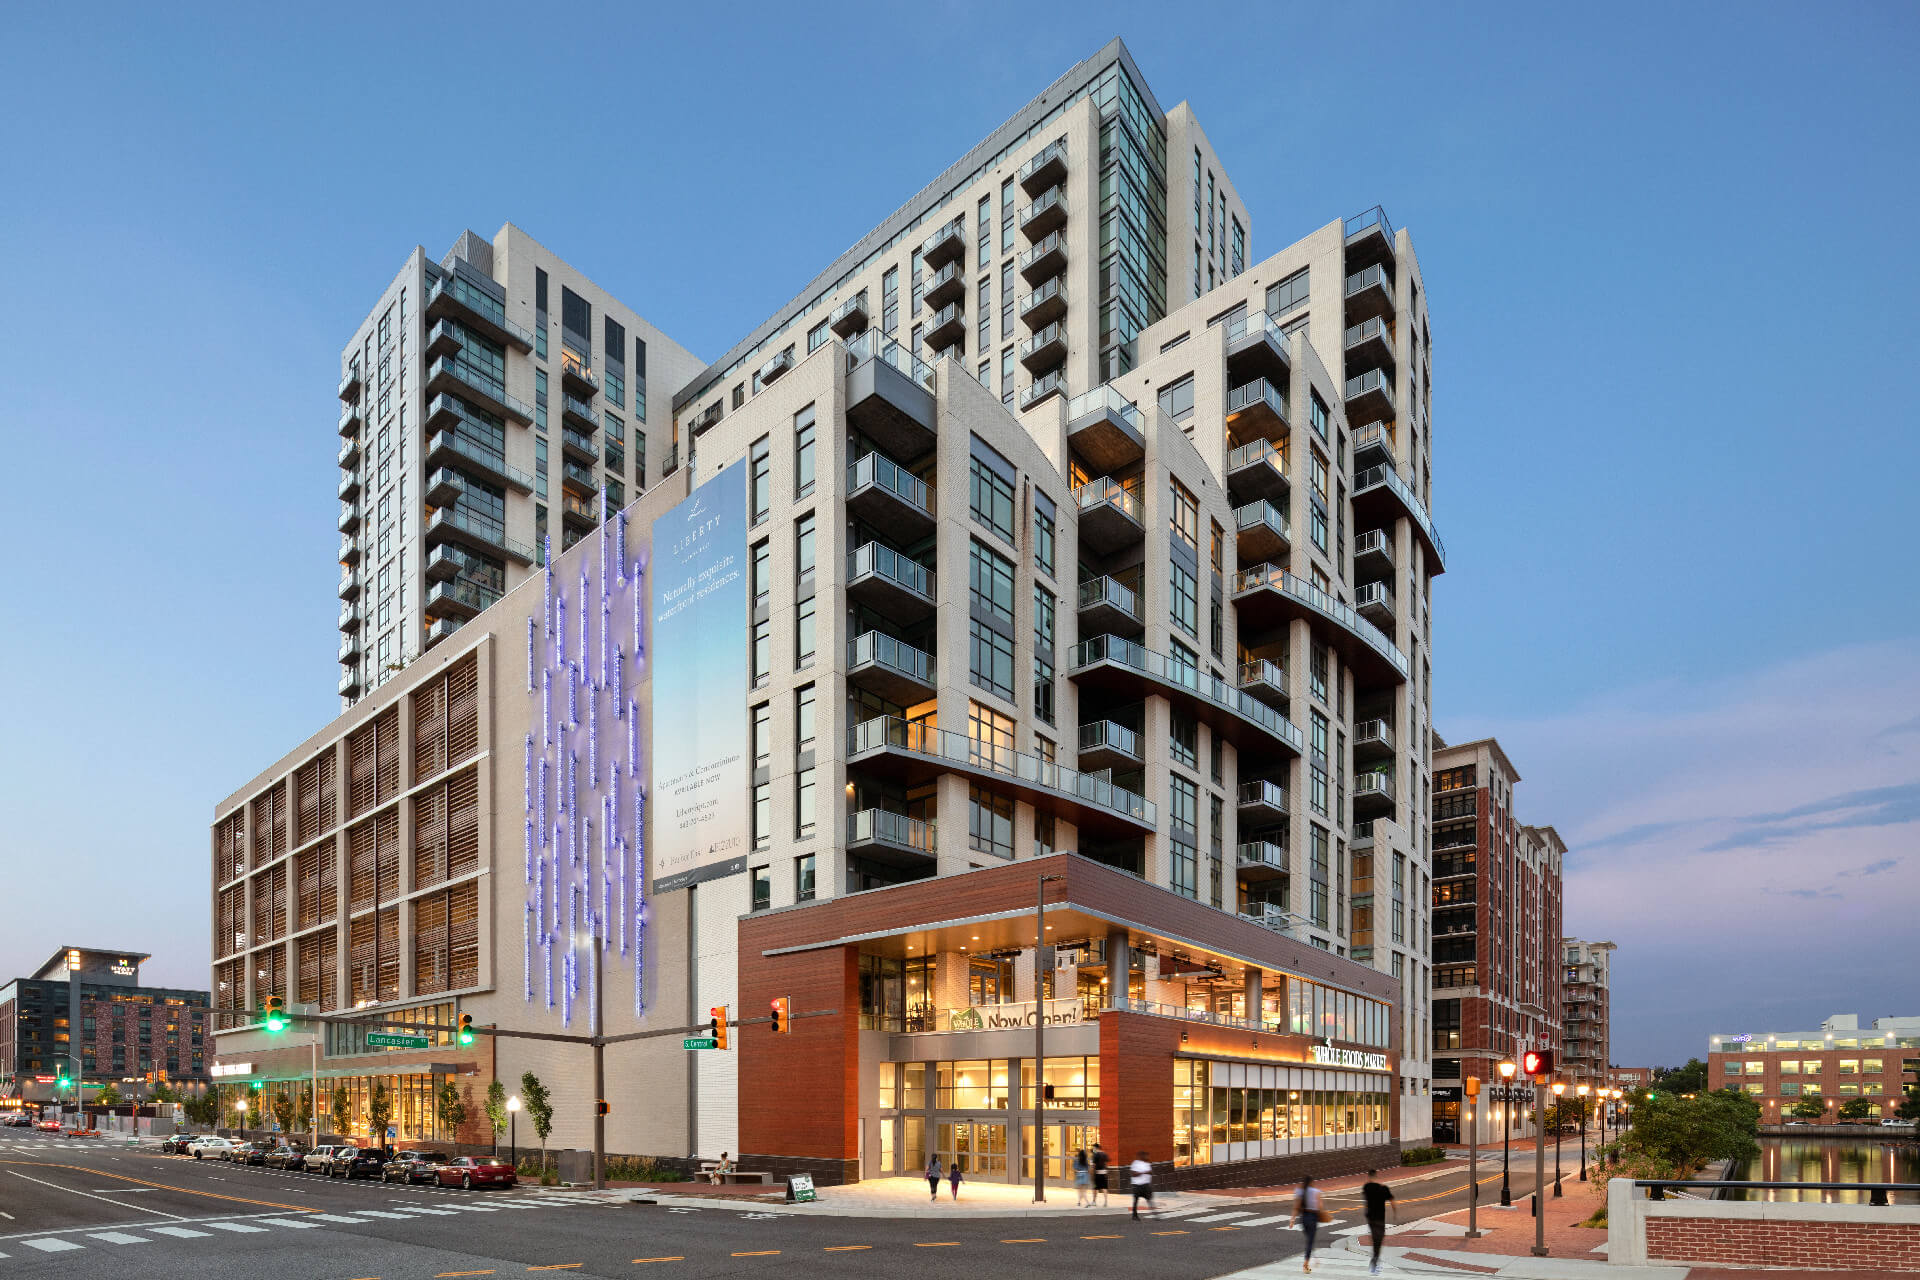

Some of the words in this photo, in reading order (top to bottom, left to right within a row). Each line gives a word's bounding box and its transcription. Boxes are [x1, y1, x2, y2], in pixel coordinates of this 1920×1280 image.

[673, 514, 721, 555] LIBERTY
[663, 576, 696, 605] Naturally
[698, 554, 735, 582] exquisite
[657, 594, 695, 624] waterfront
[705, 773, 721, 785] NOW
[953, 1017, 980, 1029] WHOLE
[989, 1013, 1023, 1029] Now
[369, 1035, 415, 1046] Lancaster
[690, 1040, 708, 1048] Central
[1315, 1046, 1341, 1065] WHOLE
[1342, 1049, 1364, 1067] FOODS
[1364, 1052, 1387, 1071] MARKET
